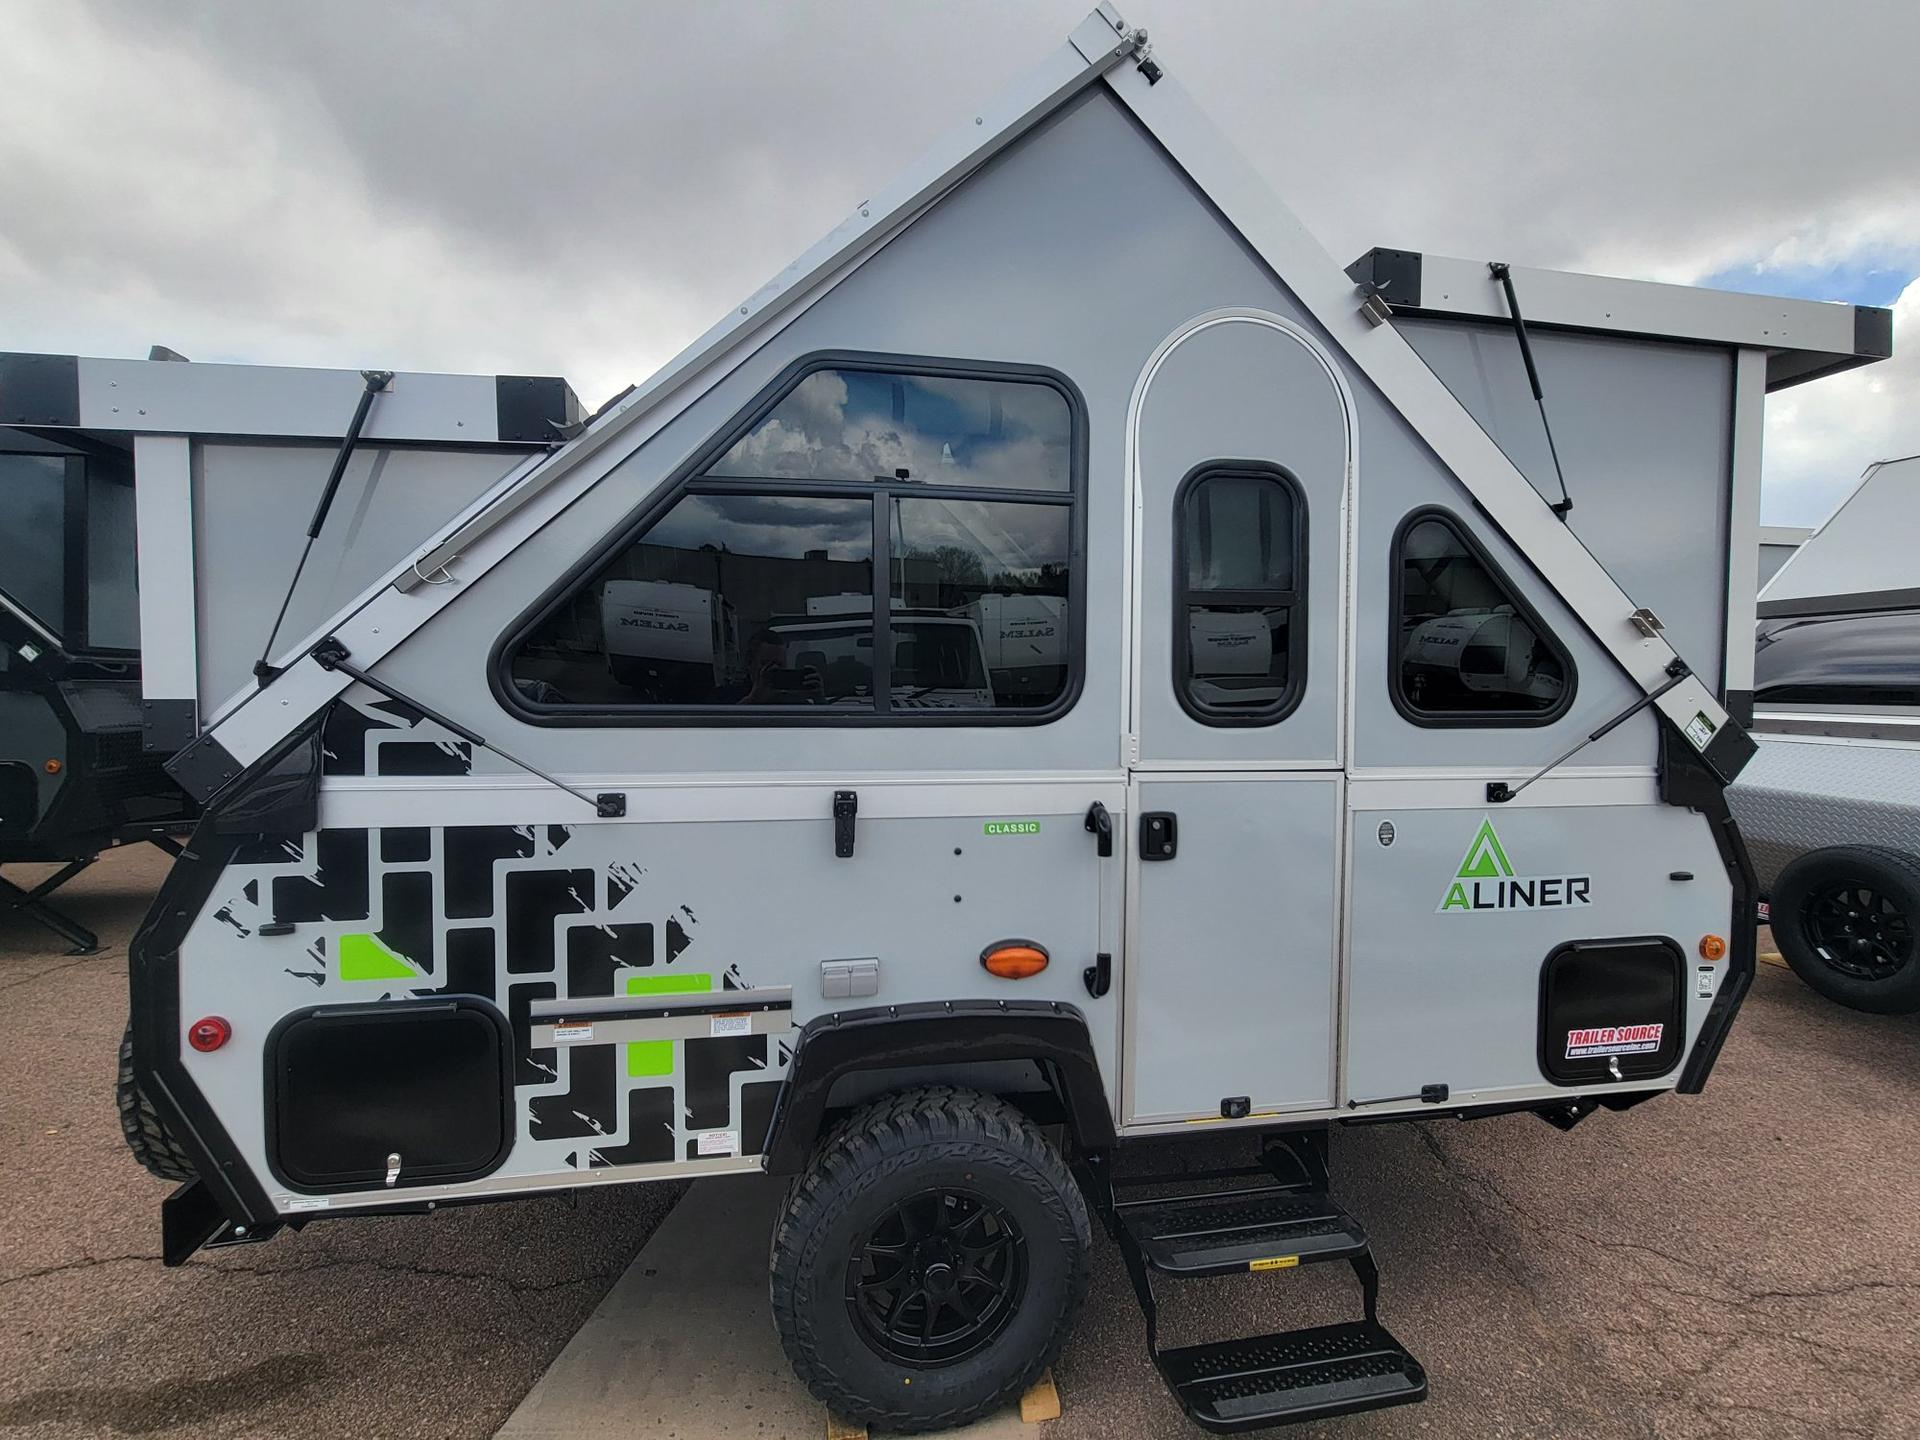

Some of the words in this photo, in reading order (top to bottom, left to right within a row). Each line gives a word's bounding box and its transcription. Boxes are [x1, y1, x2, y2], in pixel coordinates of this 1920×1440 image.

[988, 823, 1037, 834] CLASSIC
[1442, 877, 1590, 910] ALINER
[1568, 1029, 1616, 1046] TRAILER
[1616, 1025, 1661, 1042] SOURCE
